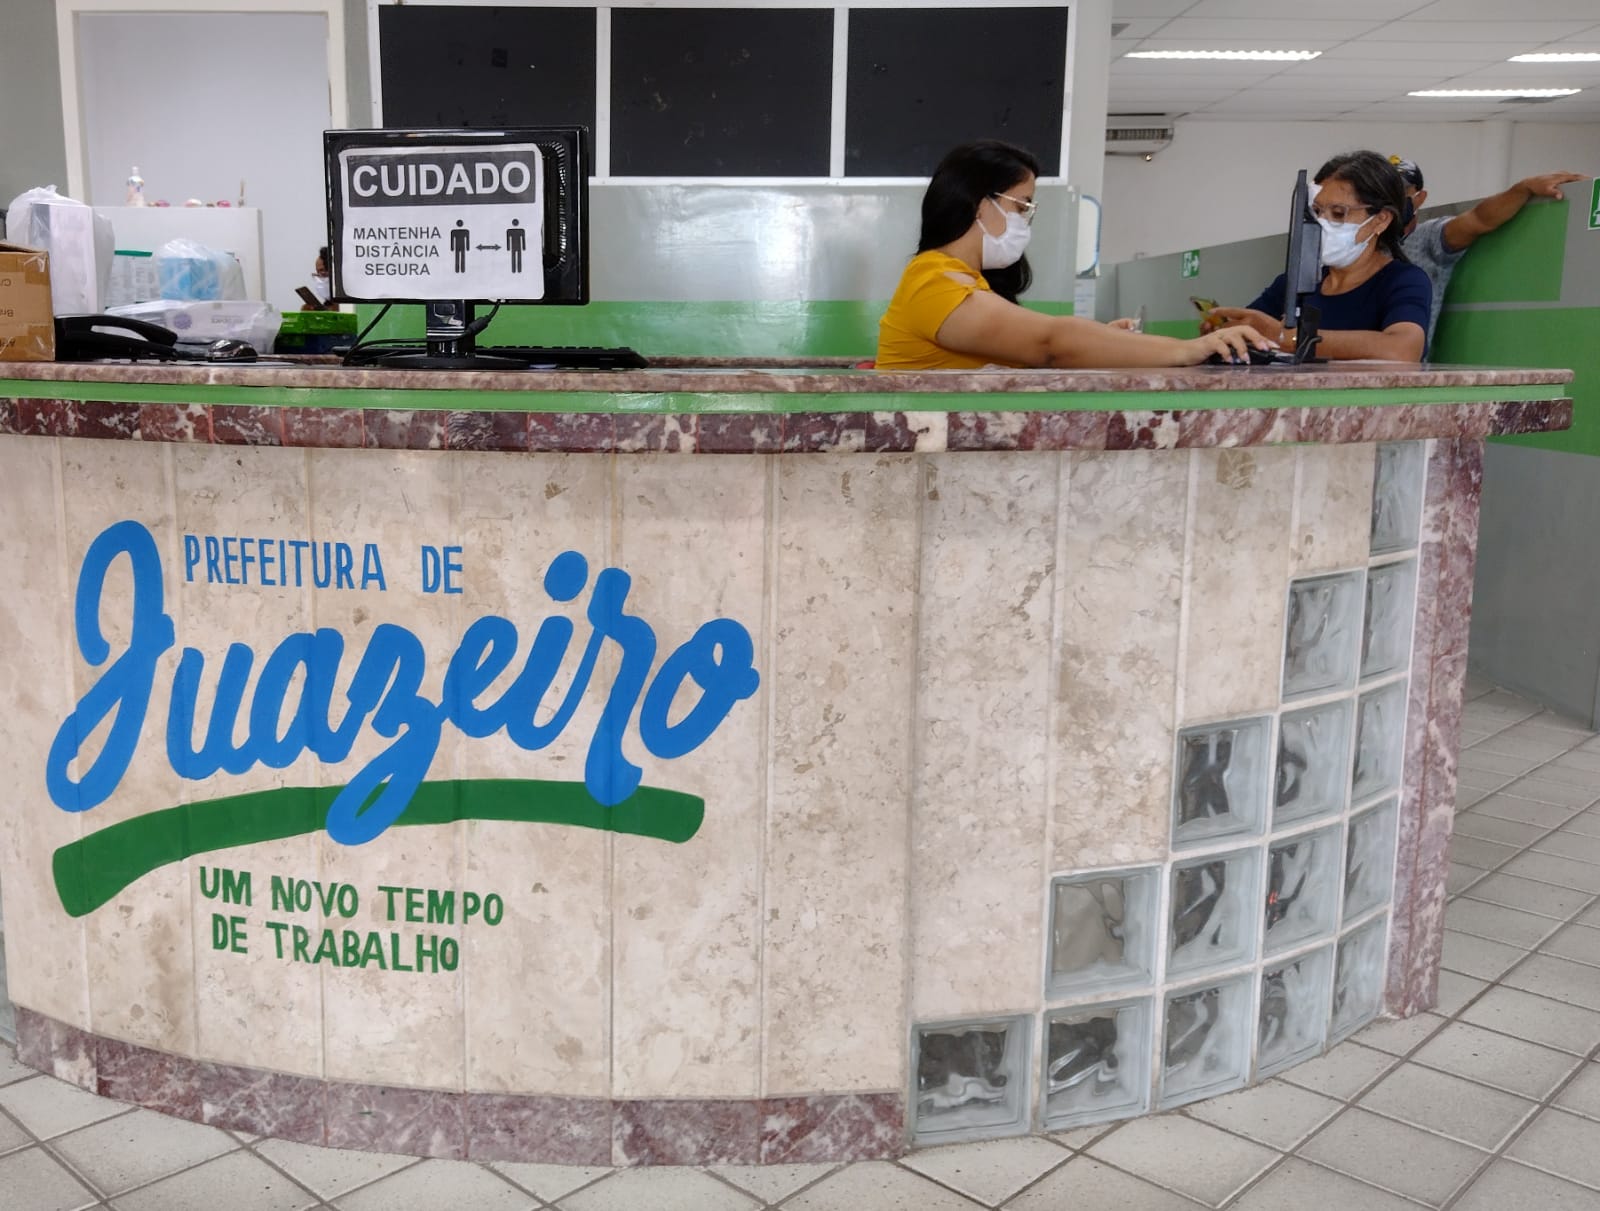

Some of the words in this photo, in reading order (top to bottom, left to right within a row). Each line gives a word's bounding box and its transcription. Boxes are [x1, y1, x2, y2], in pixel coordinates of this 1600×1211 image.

[353, 161, 531, 197] CUIDADO
[353, 226, 441, 240] MANTENHA
[355, 242, 439, 258] DISTÂNCIA
[364, 263, 430, 276] SEGURA
[184, 534, 387, 591] PREFEITURA
[421, 545, 463, 594] DE
[46, 520, 760, 844] Juazeiro
[199, 866, 252, 907] UM
[271, 875, 359, 919] NOVO
[378, 885, 504, 926] TEMPO
[211, 913, 249, 954] DE
[265, 921, 460, 974] TRABALHO
